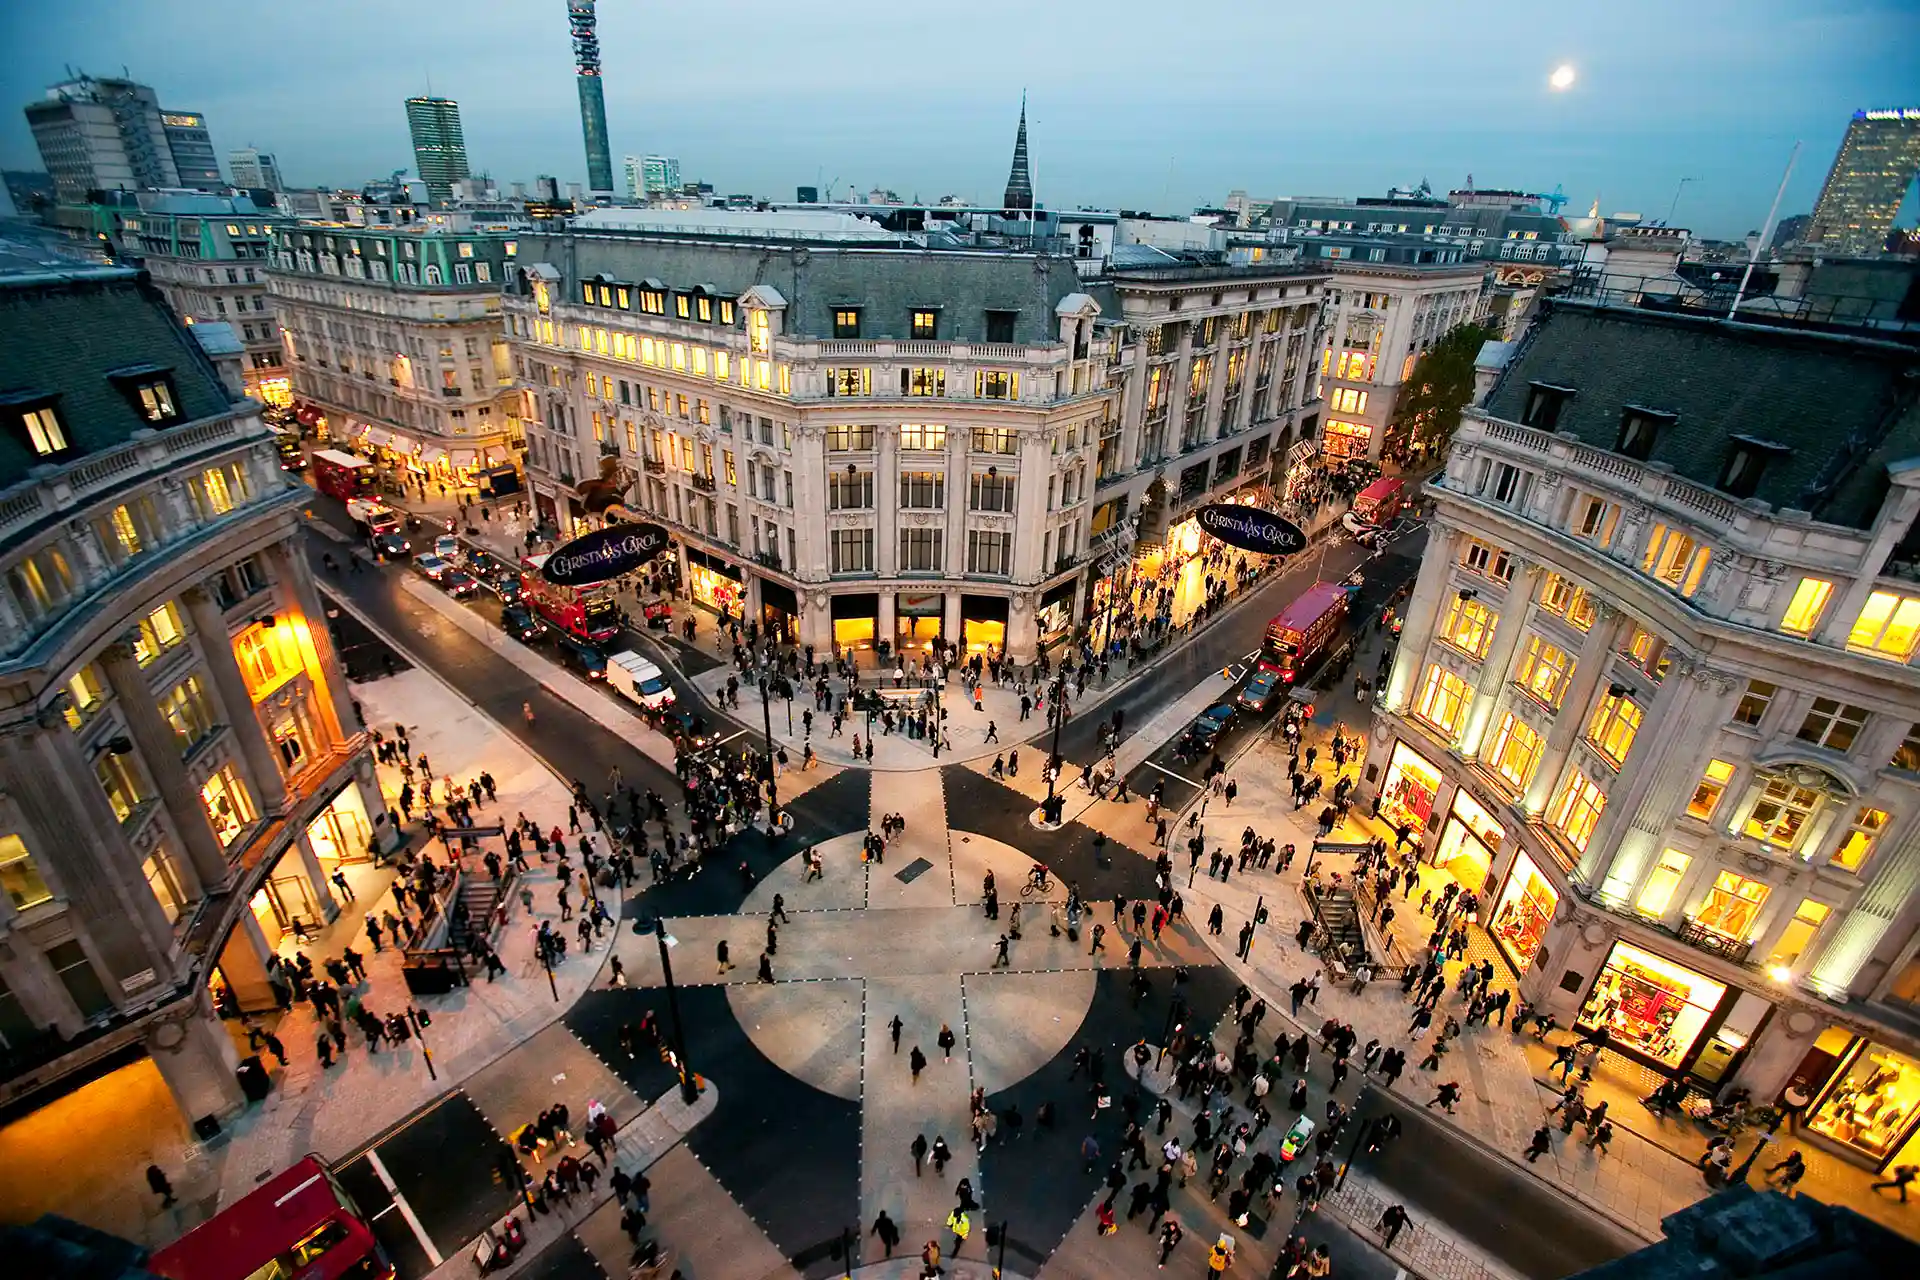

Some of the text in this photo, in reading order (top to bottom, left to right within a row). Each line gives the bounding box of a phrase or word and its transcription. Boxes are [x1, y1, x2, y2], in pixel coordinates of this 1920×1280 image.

[1204, 508, 1296, 546] CHRISTMAS CAROL
[551, 533, 660, 576] CHRISTMAS CAROL
